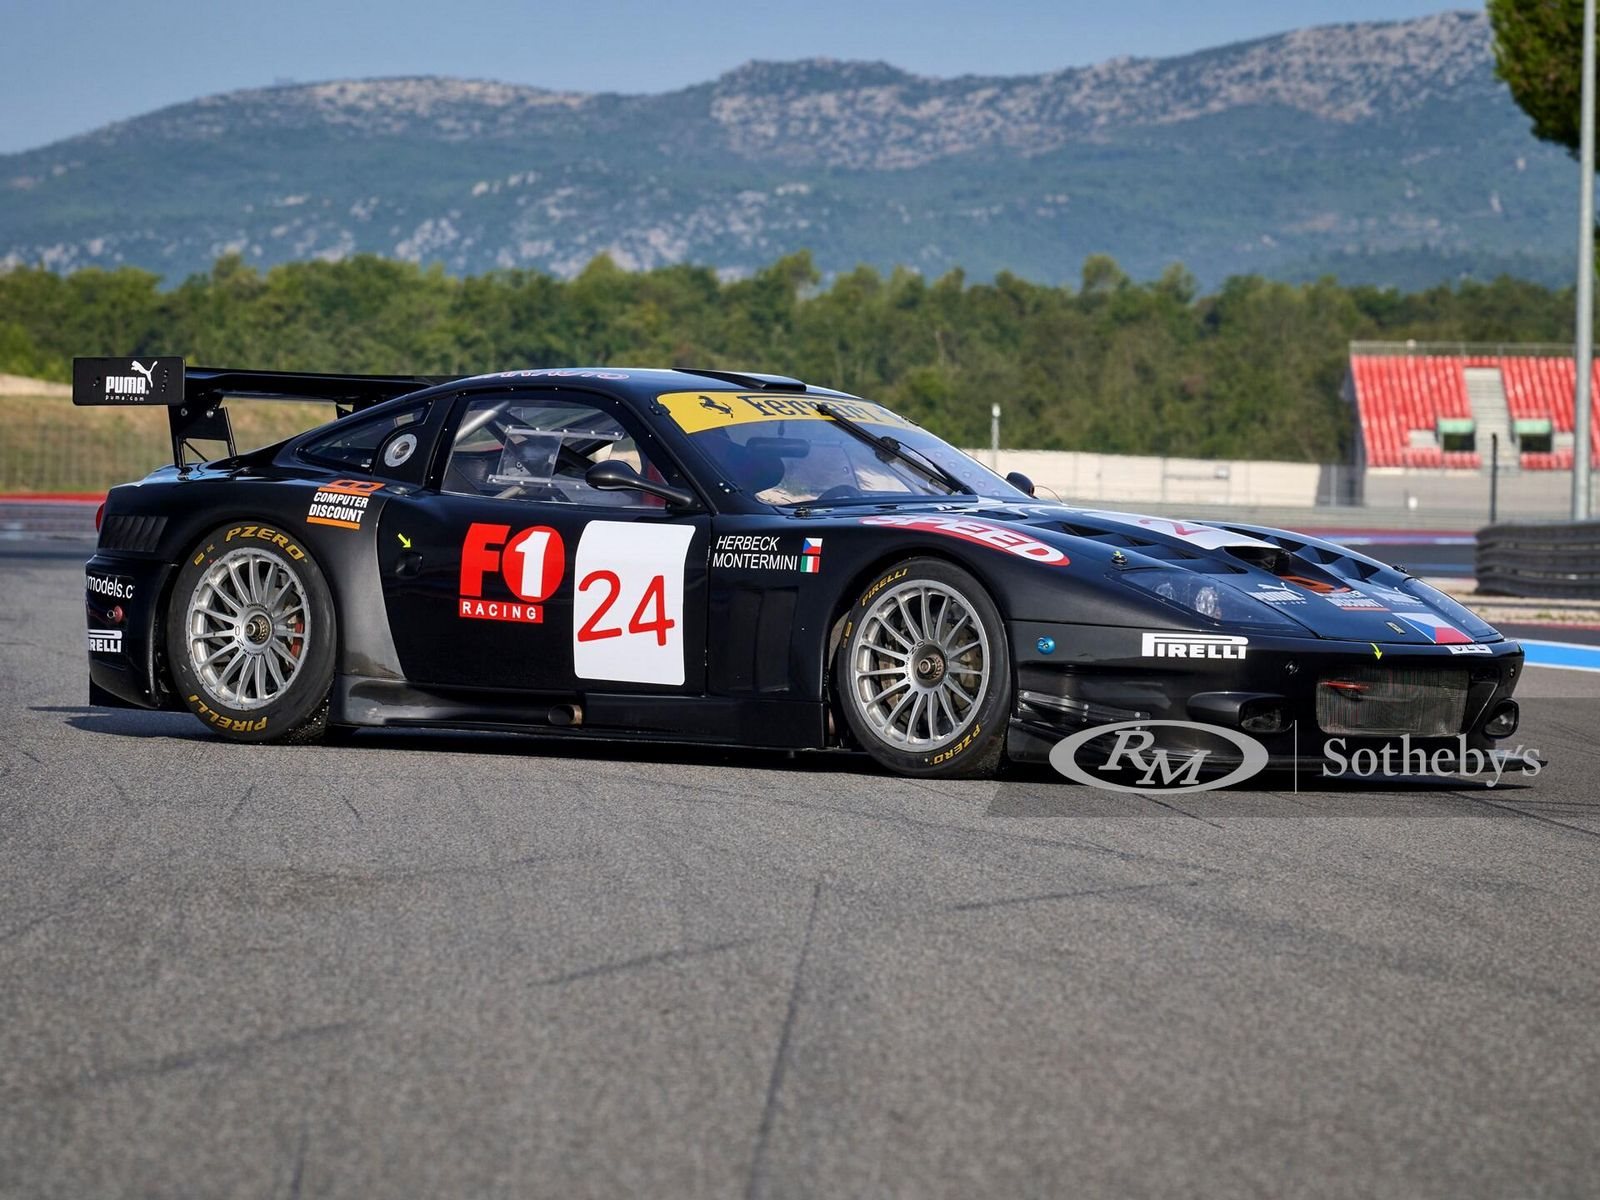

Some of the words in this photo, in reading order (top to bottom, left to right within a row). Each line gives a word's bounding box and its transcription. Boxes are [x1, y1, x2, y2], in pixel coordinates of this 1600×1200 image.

[105, 375, 146, 394] PUMA
[308, 503, 365, 523] DISCOUNT
[313, 491, 369, 508] COMPUTER
[225, 526, 305, 560] PZERO
[716, 535, 780, 551] HERBECK
[862, 515, 1064, 562] SPEED
[459, 522, 565, 603] F1
[712, 553, 798, 571] MONTERMINI
[861, 567, 909, 607] PIRELLI
[461, 600, 537, 620] RACING
[577, 569, 675, 646] 24
[1141, 633, 1249, 660] PIRELLI
[188, 694, 270, 733] PIRELLI
[933, 722, 982, 765] PZERO
